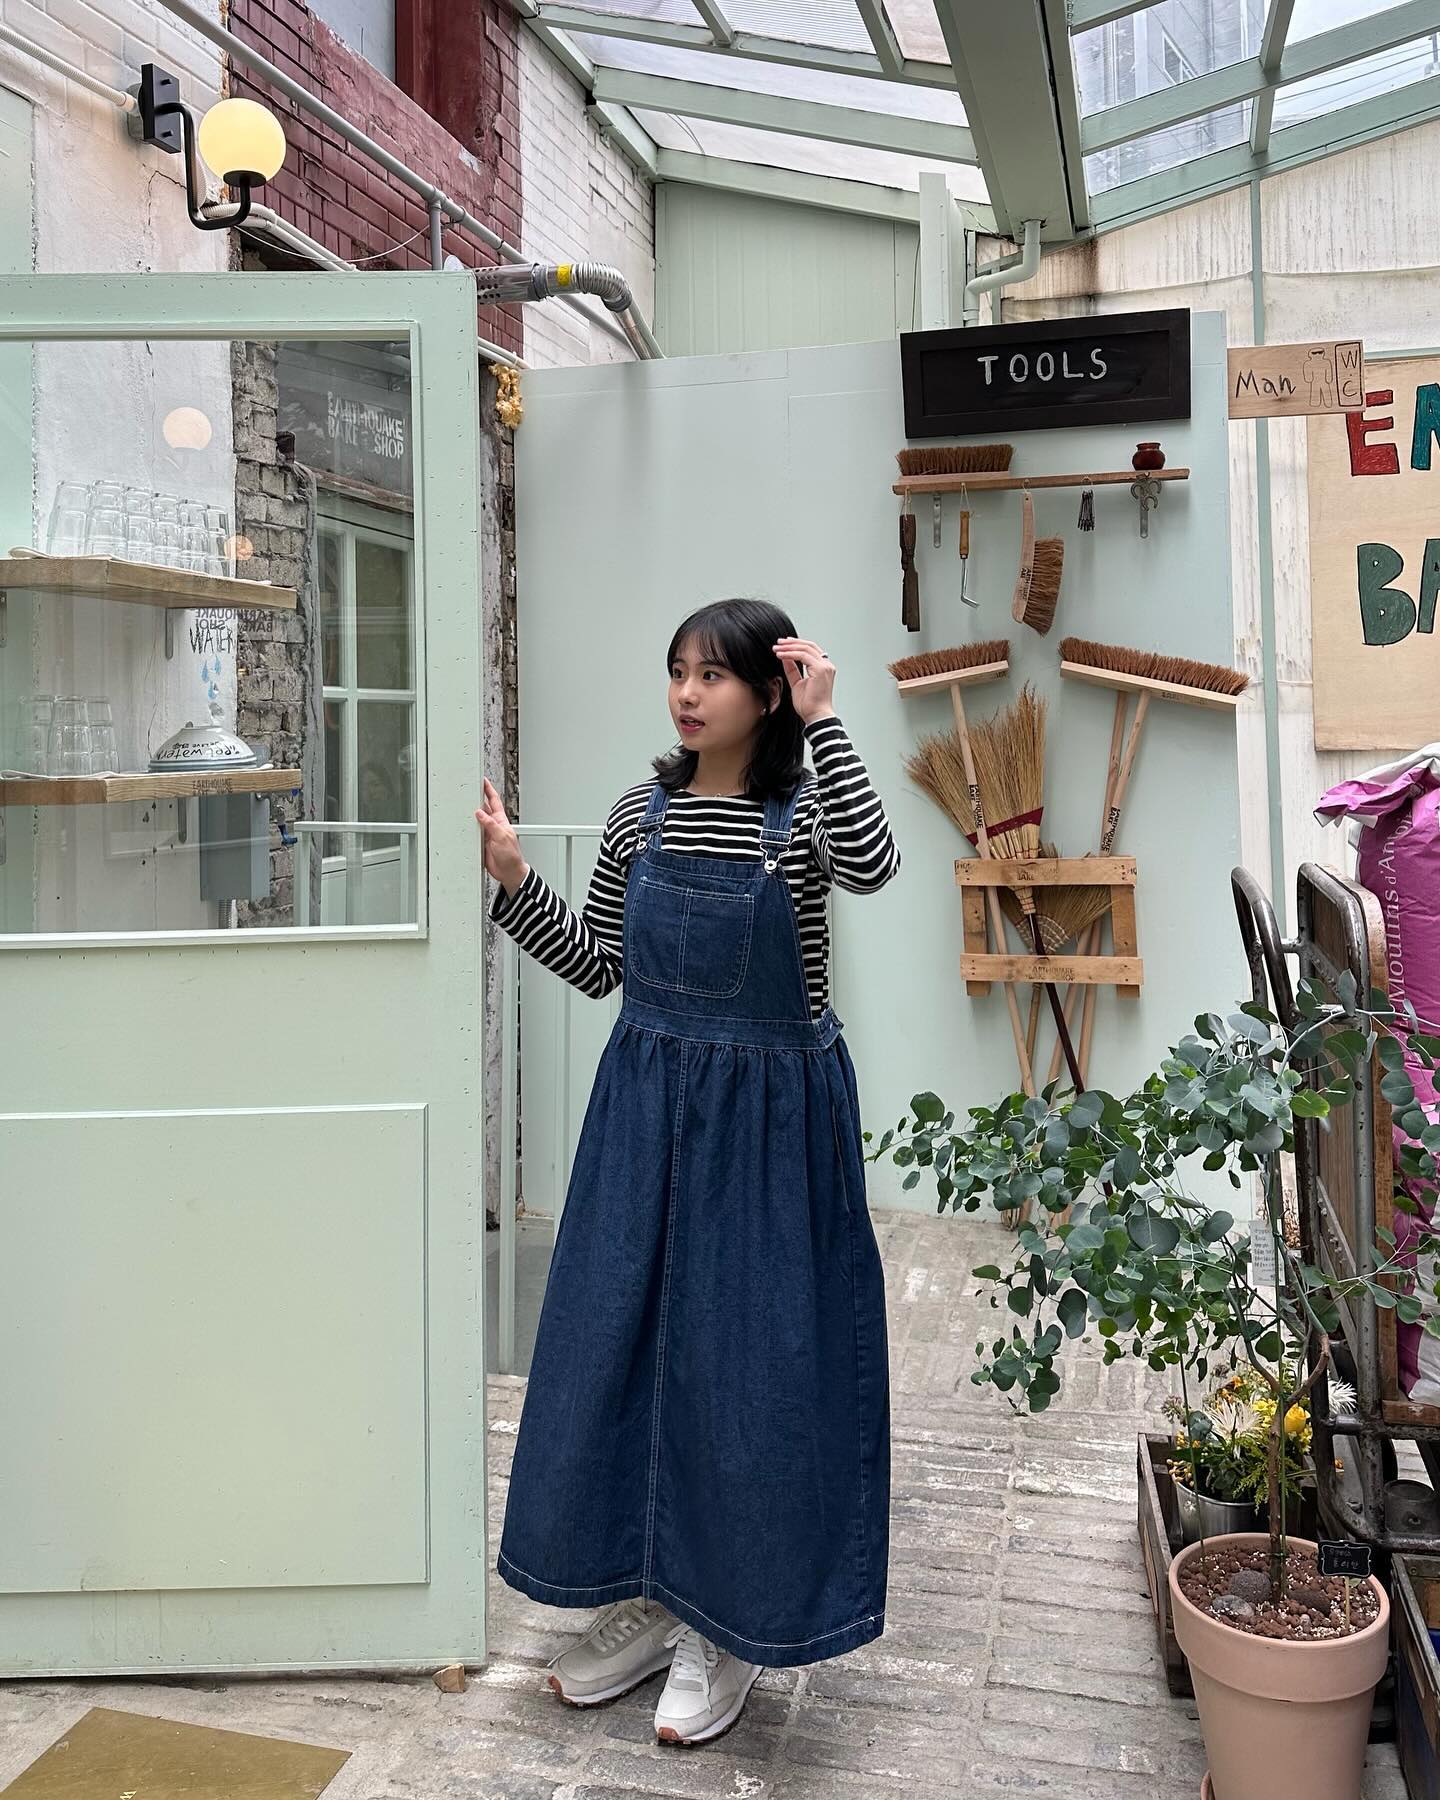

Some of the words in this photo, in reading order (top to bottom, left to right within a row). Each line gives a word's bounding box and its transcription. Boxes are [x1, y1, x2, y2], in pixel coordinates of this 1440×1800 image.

[977, 348, 1107, 385] TOOLS
[1235, 369, 1296, 398] Man
[374, 433, 404, 460] SHOP
[1384, 889, 1406, 1003] Moulins
